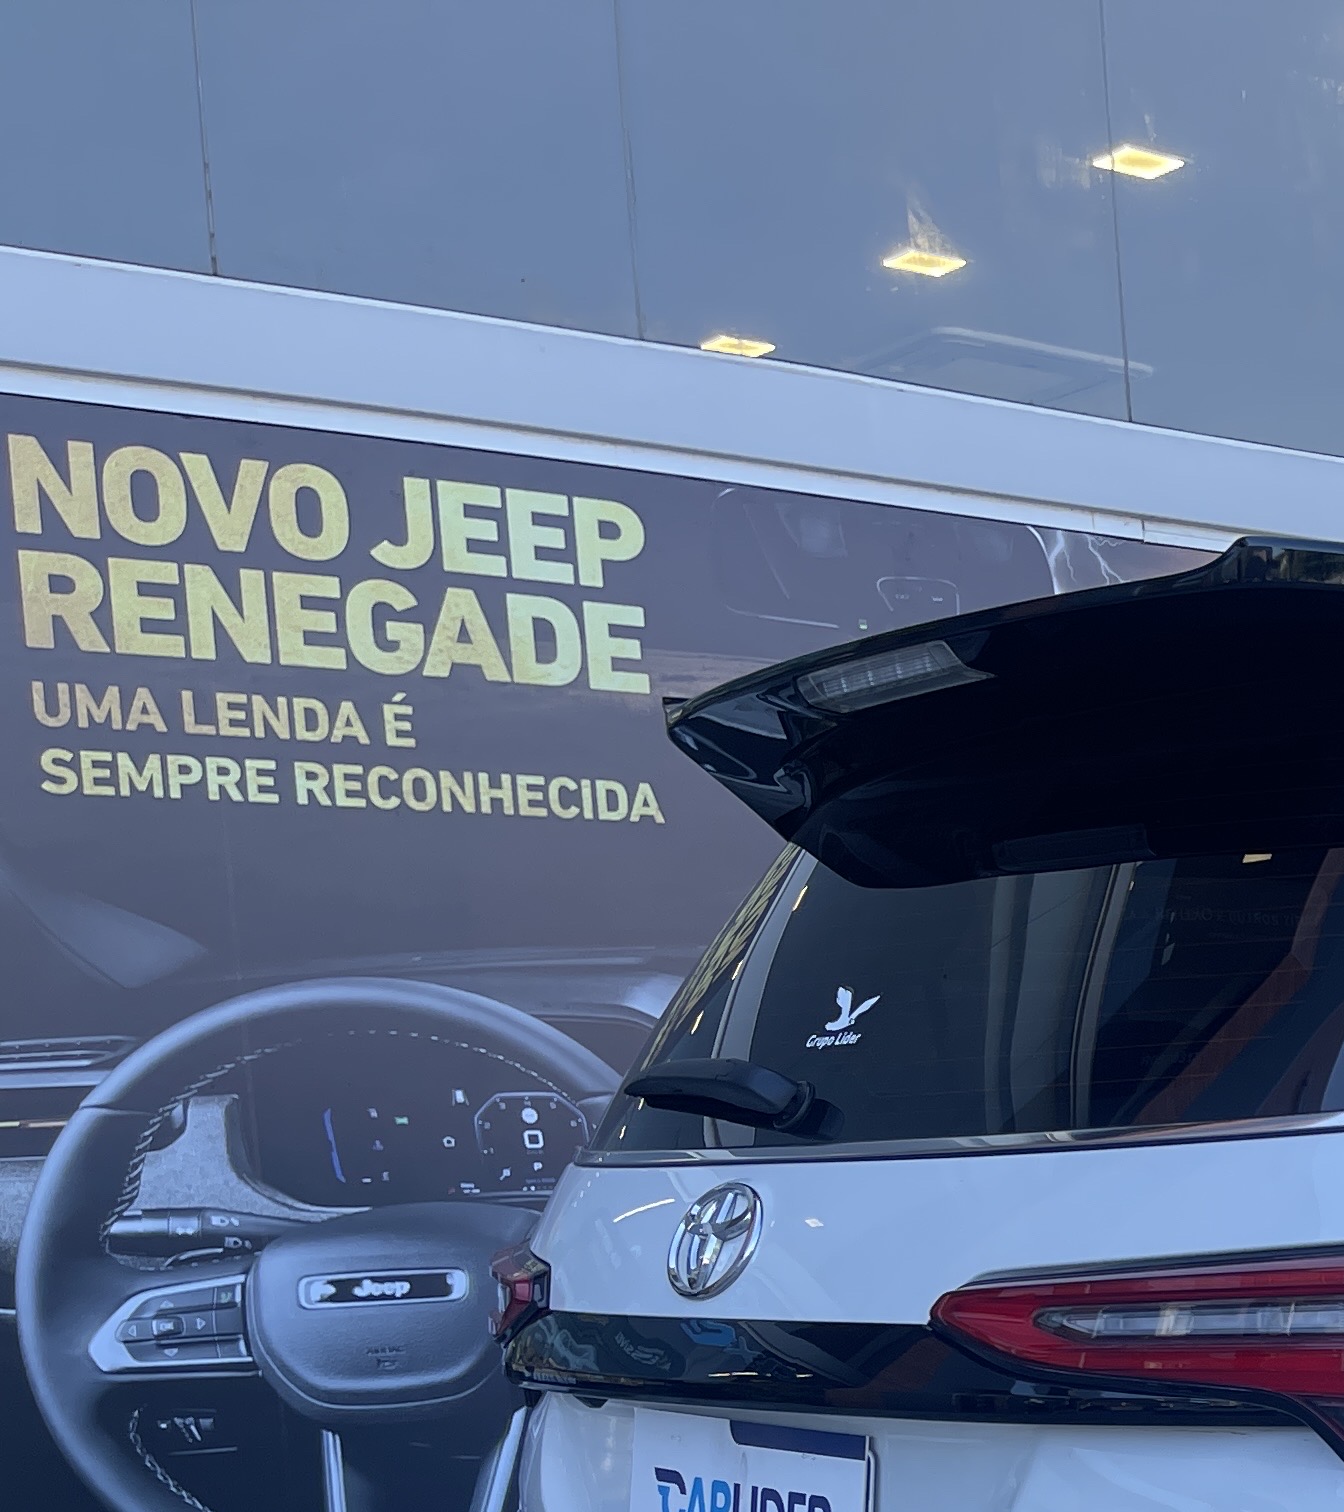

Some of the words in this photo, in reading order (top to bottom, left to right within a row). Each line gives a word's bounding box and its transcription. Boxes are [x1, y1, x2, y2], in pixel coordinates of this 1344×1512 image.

[7, 433, 350, 562] NOVO
[370, 476, 645, 588] JEEP
[17, 549, 651, 694] RENEGADE
[31, 680, 168, 733] UMA
[183, 689, 370, 745] LENDA
[384, 693, 416, 748] É
[39, 748, 279, 804] SEMPRE
[295, 760, 665, 824] RECONHECIDA
[805, 1034, 835, 1049] Grupo
[351, 1279, 411, 1298] Jeep
